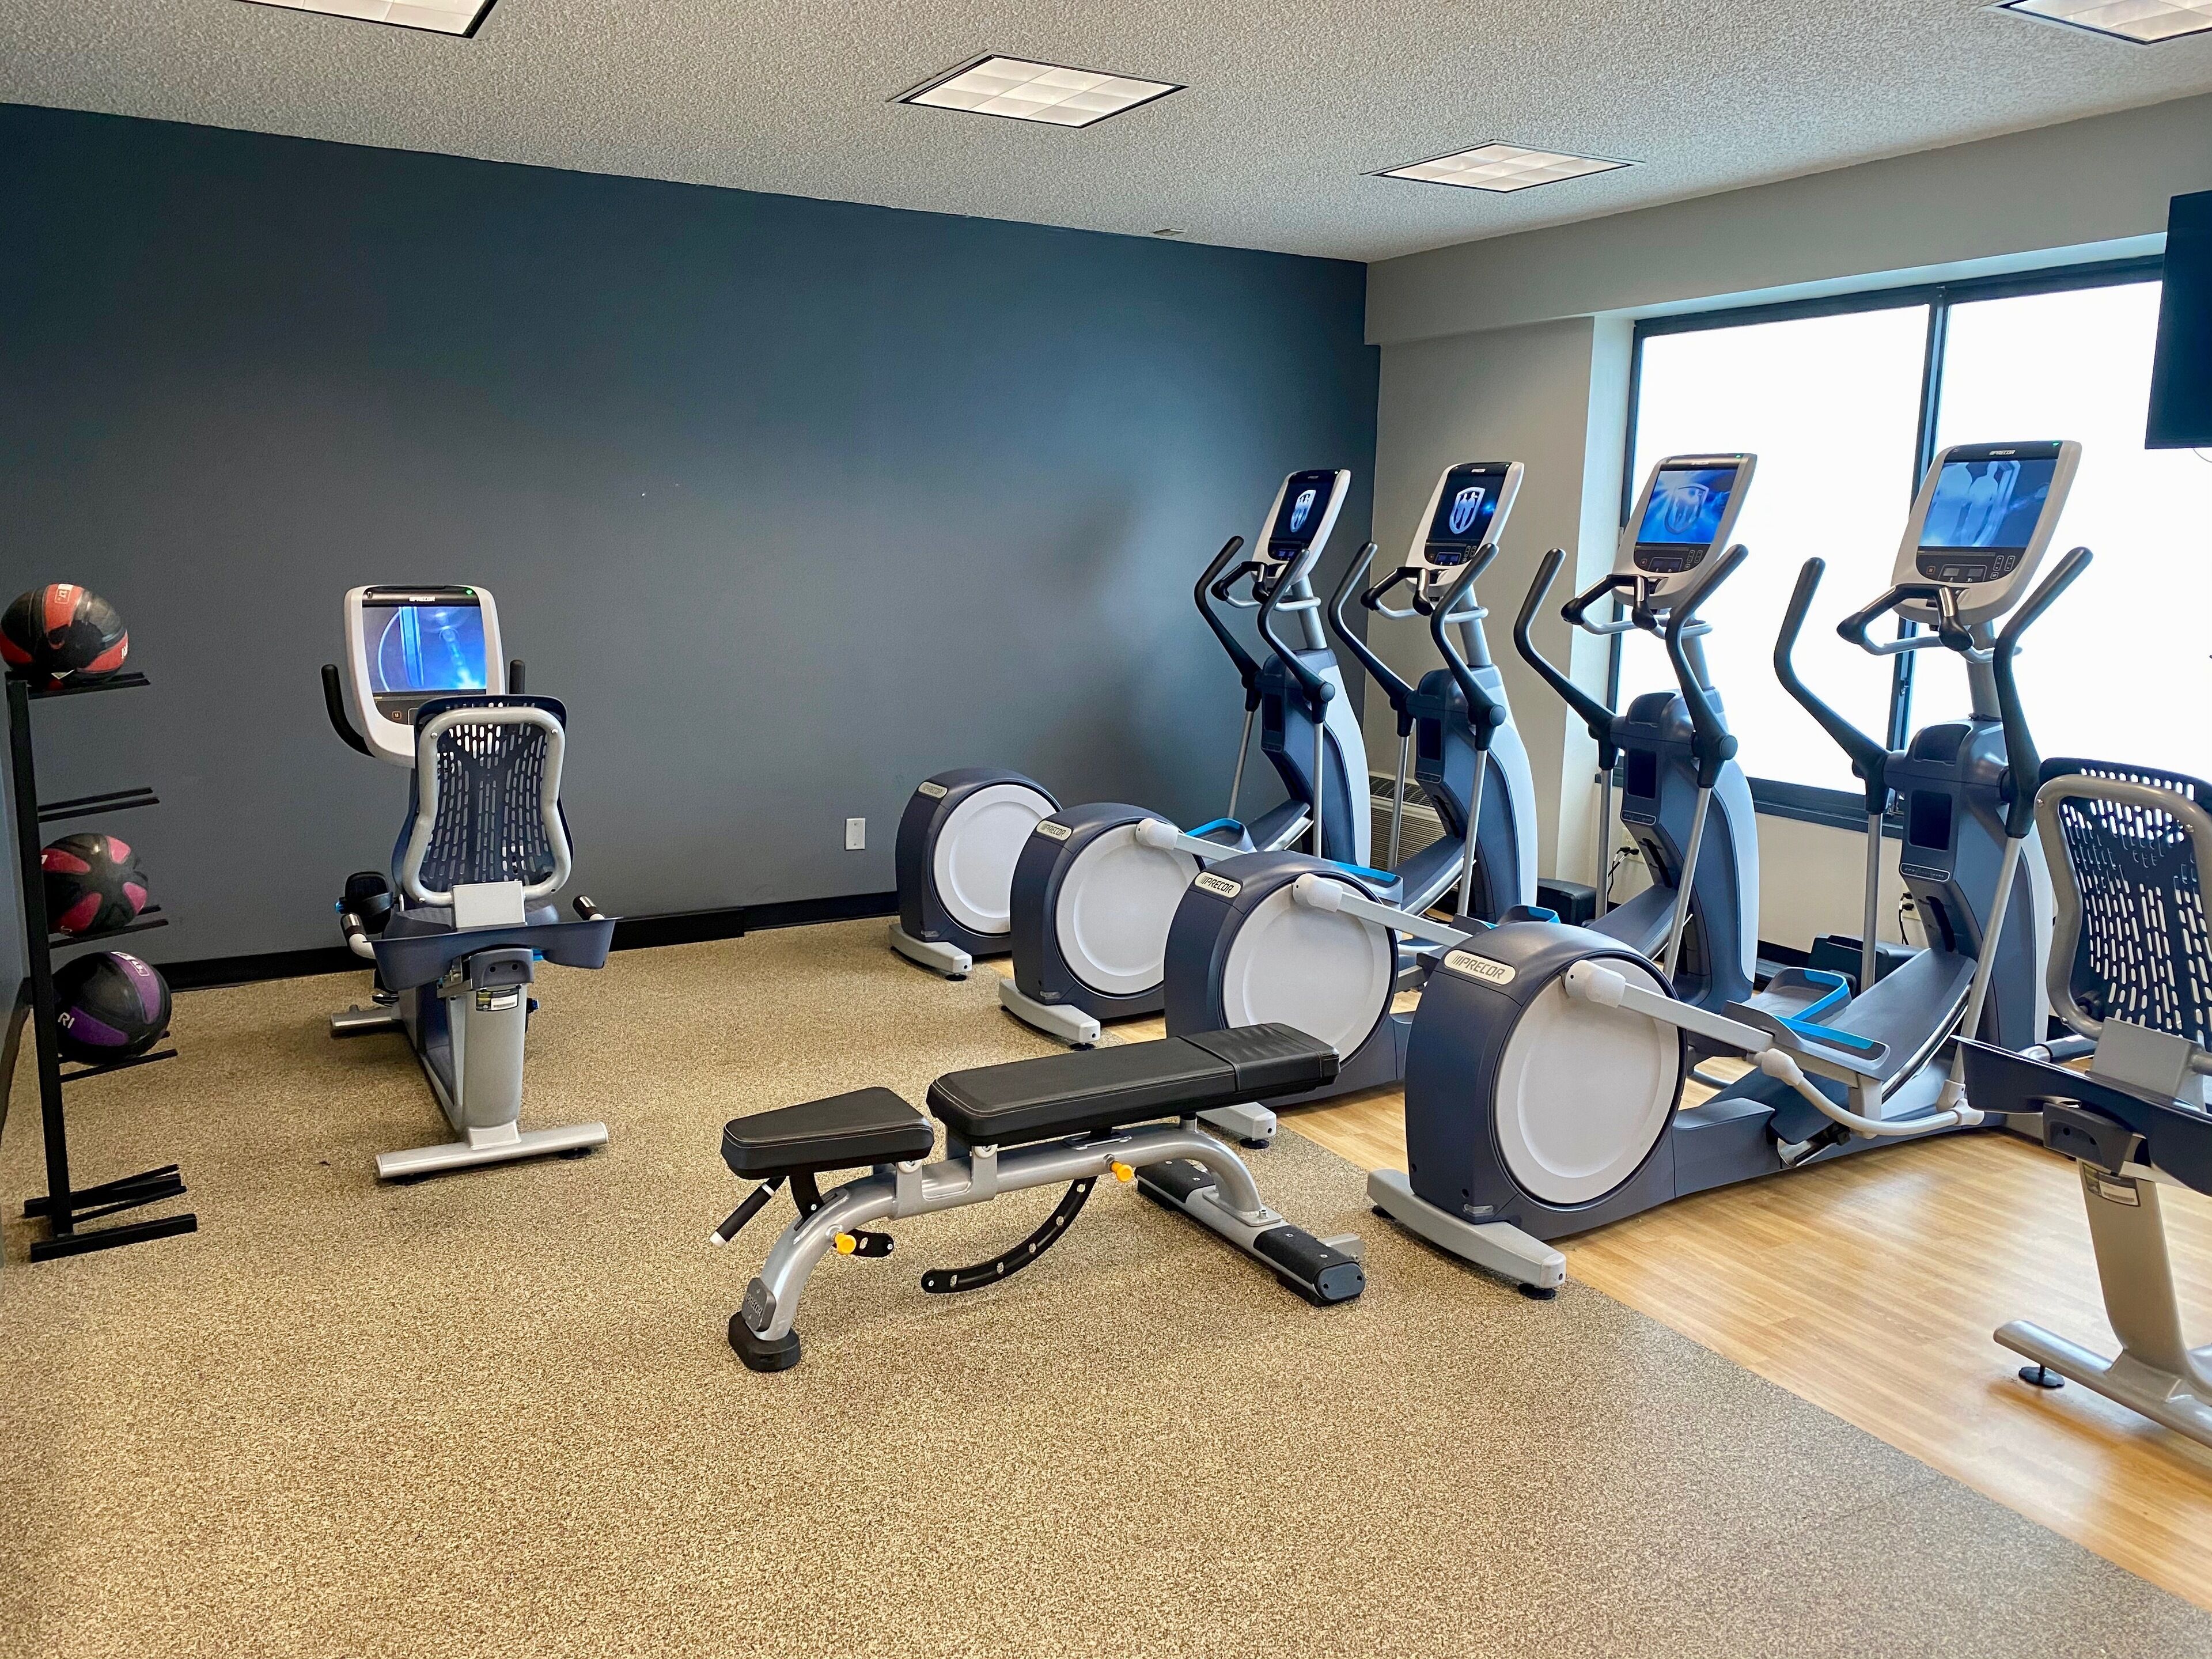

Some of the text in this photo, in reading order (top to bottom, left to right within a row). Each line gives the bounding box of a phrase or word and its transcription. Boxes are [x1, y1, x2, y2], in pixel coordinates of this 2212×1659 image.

[1044, 824, 1066, 837] PRECOR
[1204, 877, 1234, 893] PRECOR
[1458, 955, 1505, 979] PRECOR
[746, 1293, 763, 1317] PRECOR
